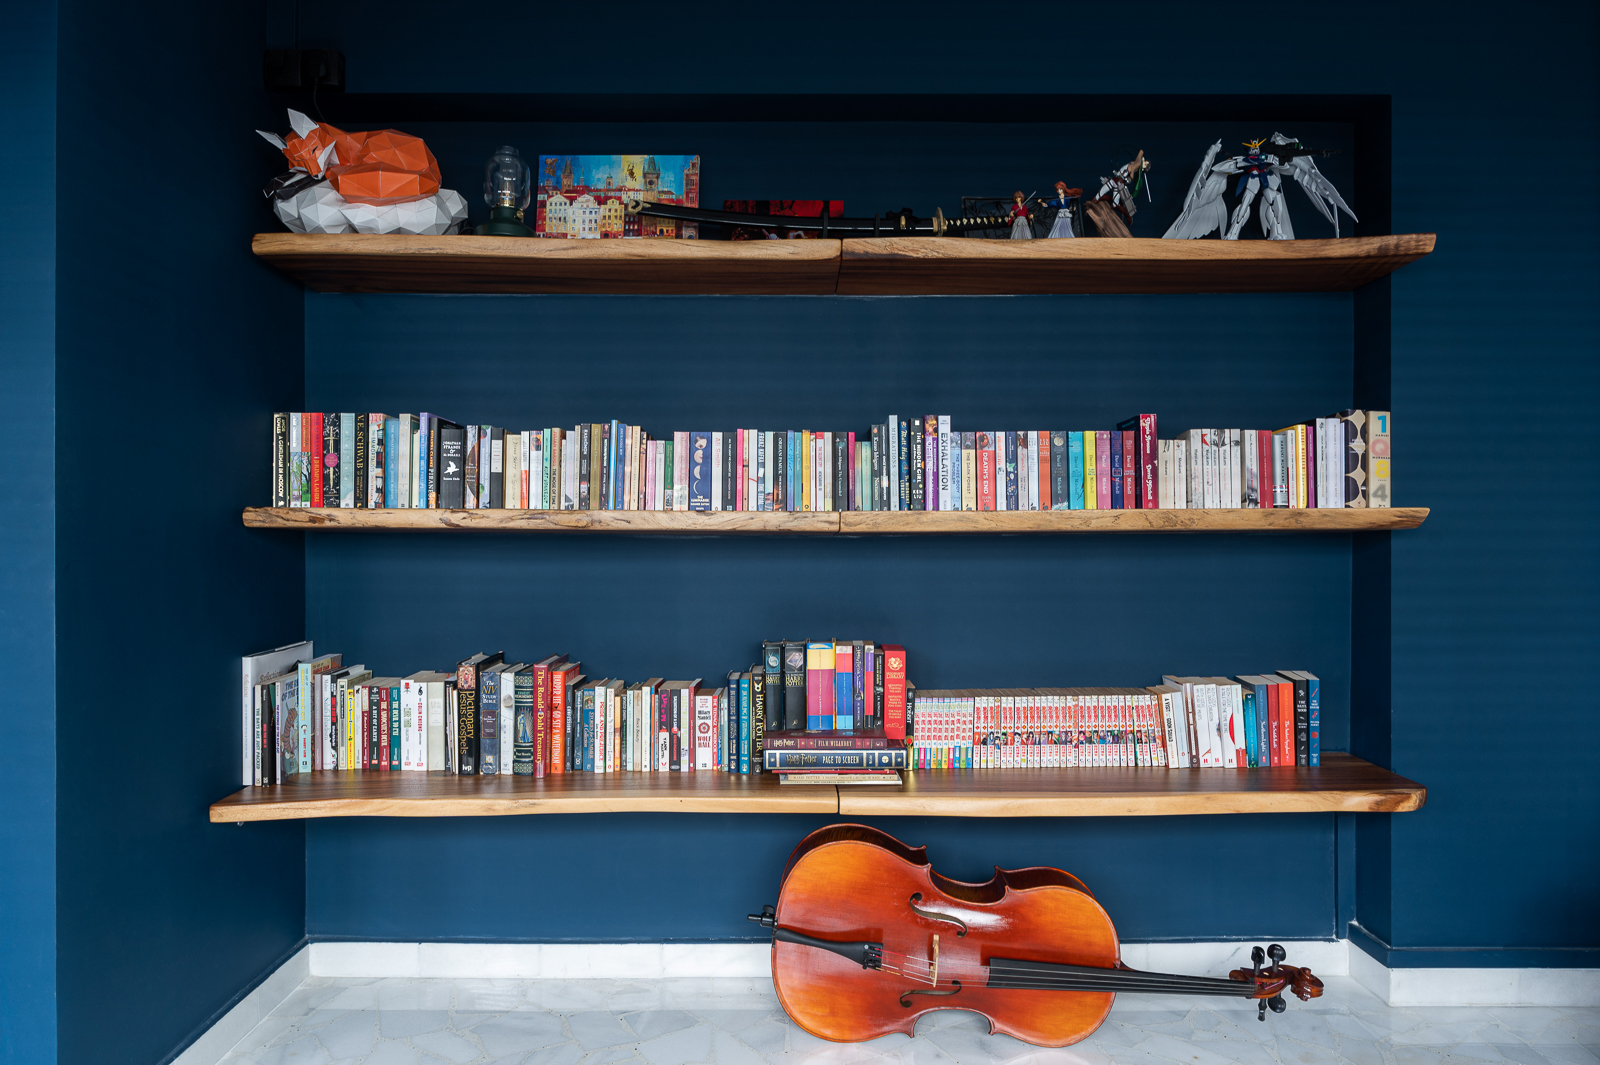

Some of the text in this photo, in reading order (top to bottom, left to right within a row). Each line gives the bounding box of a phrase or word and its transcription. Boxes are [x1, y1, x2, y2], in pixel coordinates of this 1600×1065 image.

[1378, 415, 1386, 433] 1
[1371, 438, 1389, 456] Q
[1375, 460, 1389, 478] 8
[1372, 484, 1388, 502] 4
[482, 686, 497, 694] NIV
[553, 675, 561, 704] HARPER LEE
[459, 690, 468, 754] Jesus Gospels
[466, 690, 475, 738] Dictionary
[553, 720, 561, 728] SET
[535, 732, 544, 764] Treasury
[552, 735, 561, 764] WATCHMAN
[842, 756, 859, 764] SCREEN
